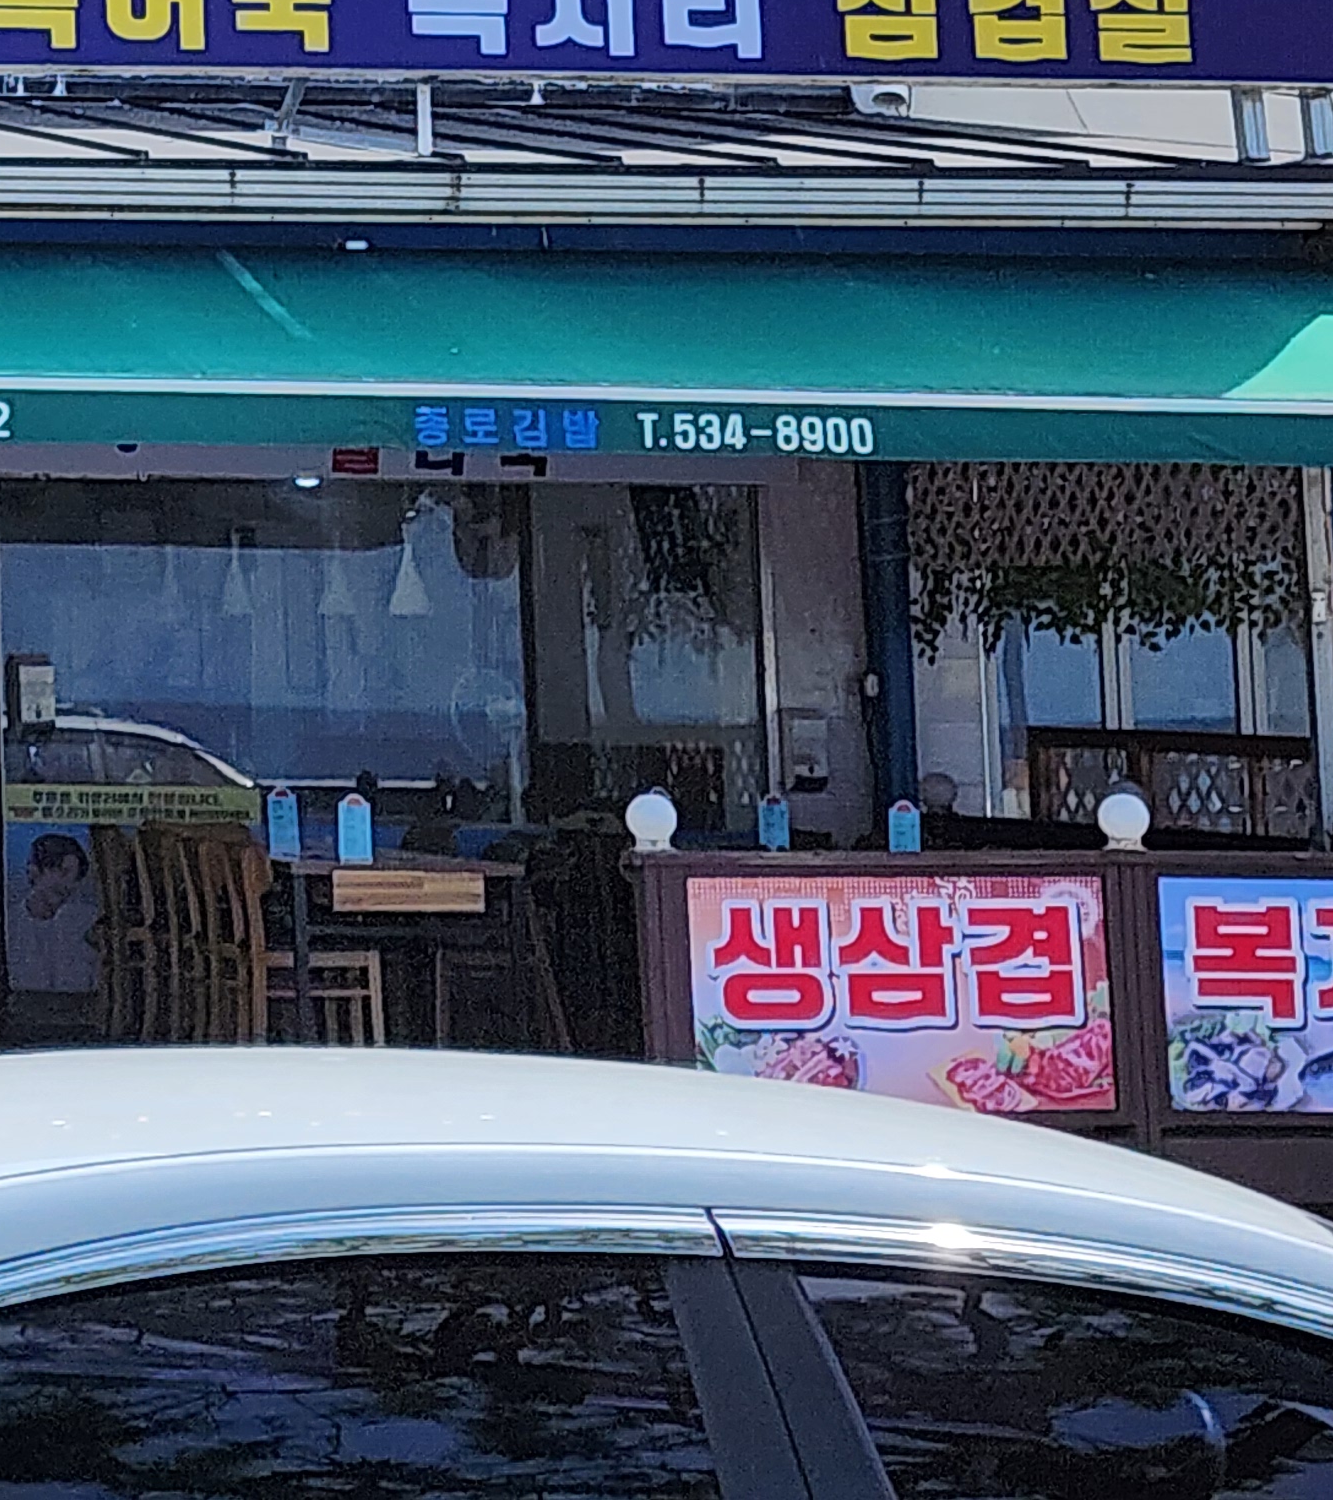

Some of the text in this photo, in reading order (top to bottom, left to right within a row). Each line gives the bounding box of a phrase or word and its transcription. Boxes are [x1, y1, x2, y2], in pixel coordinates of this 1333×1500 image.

[414, 405, 875, 455] 종로김밥 T.534-8900
[714, 905, 1075, 1020] 생삼겹
[1193, 905, 1333, 1019] 복
